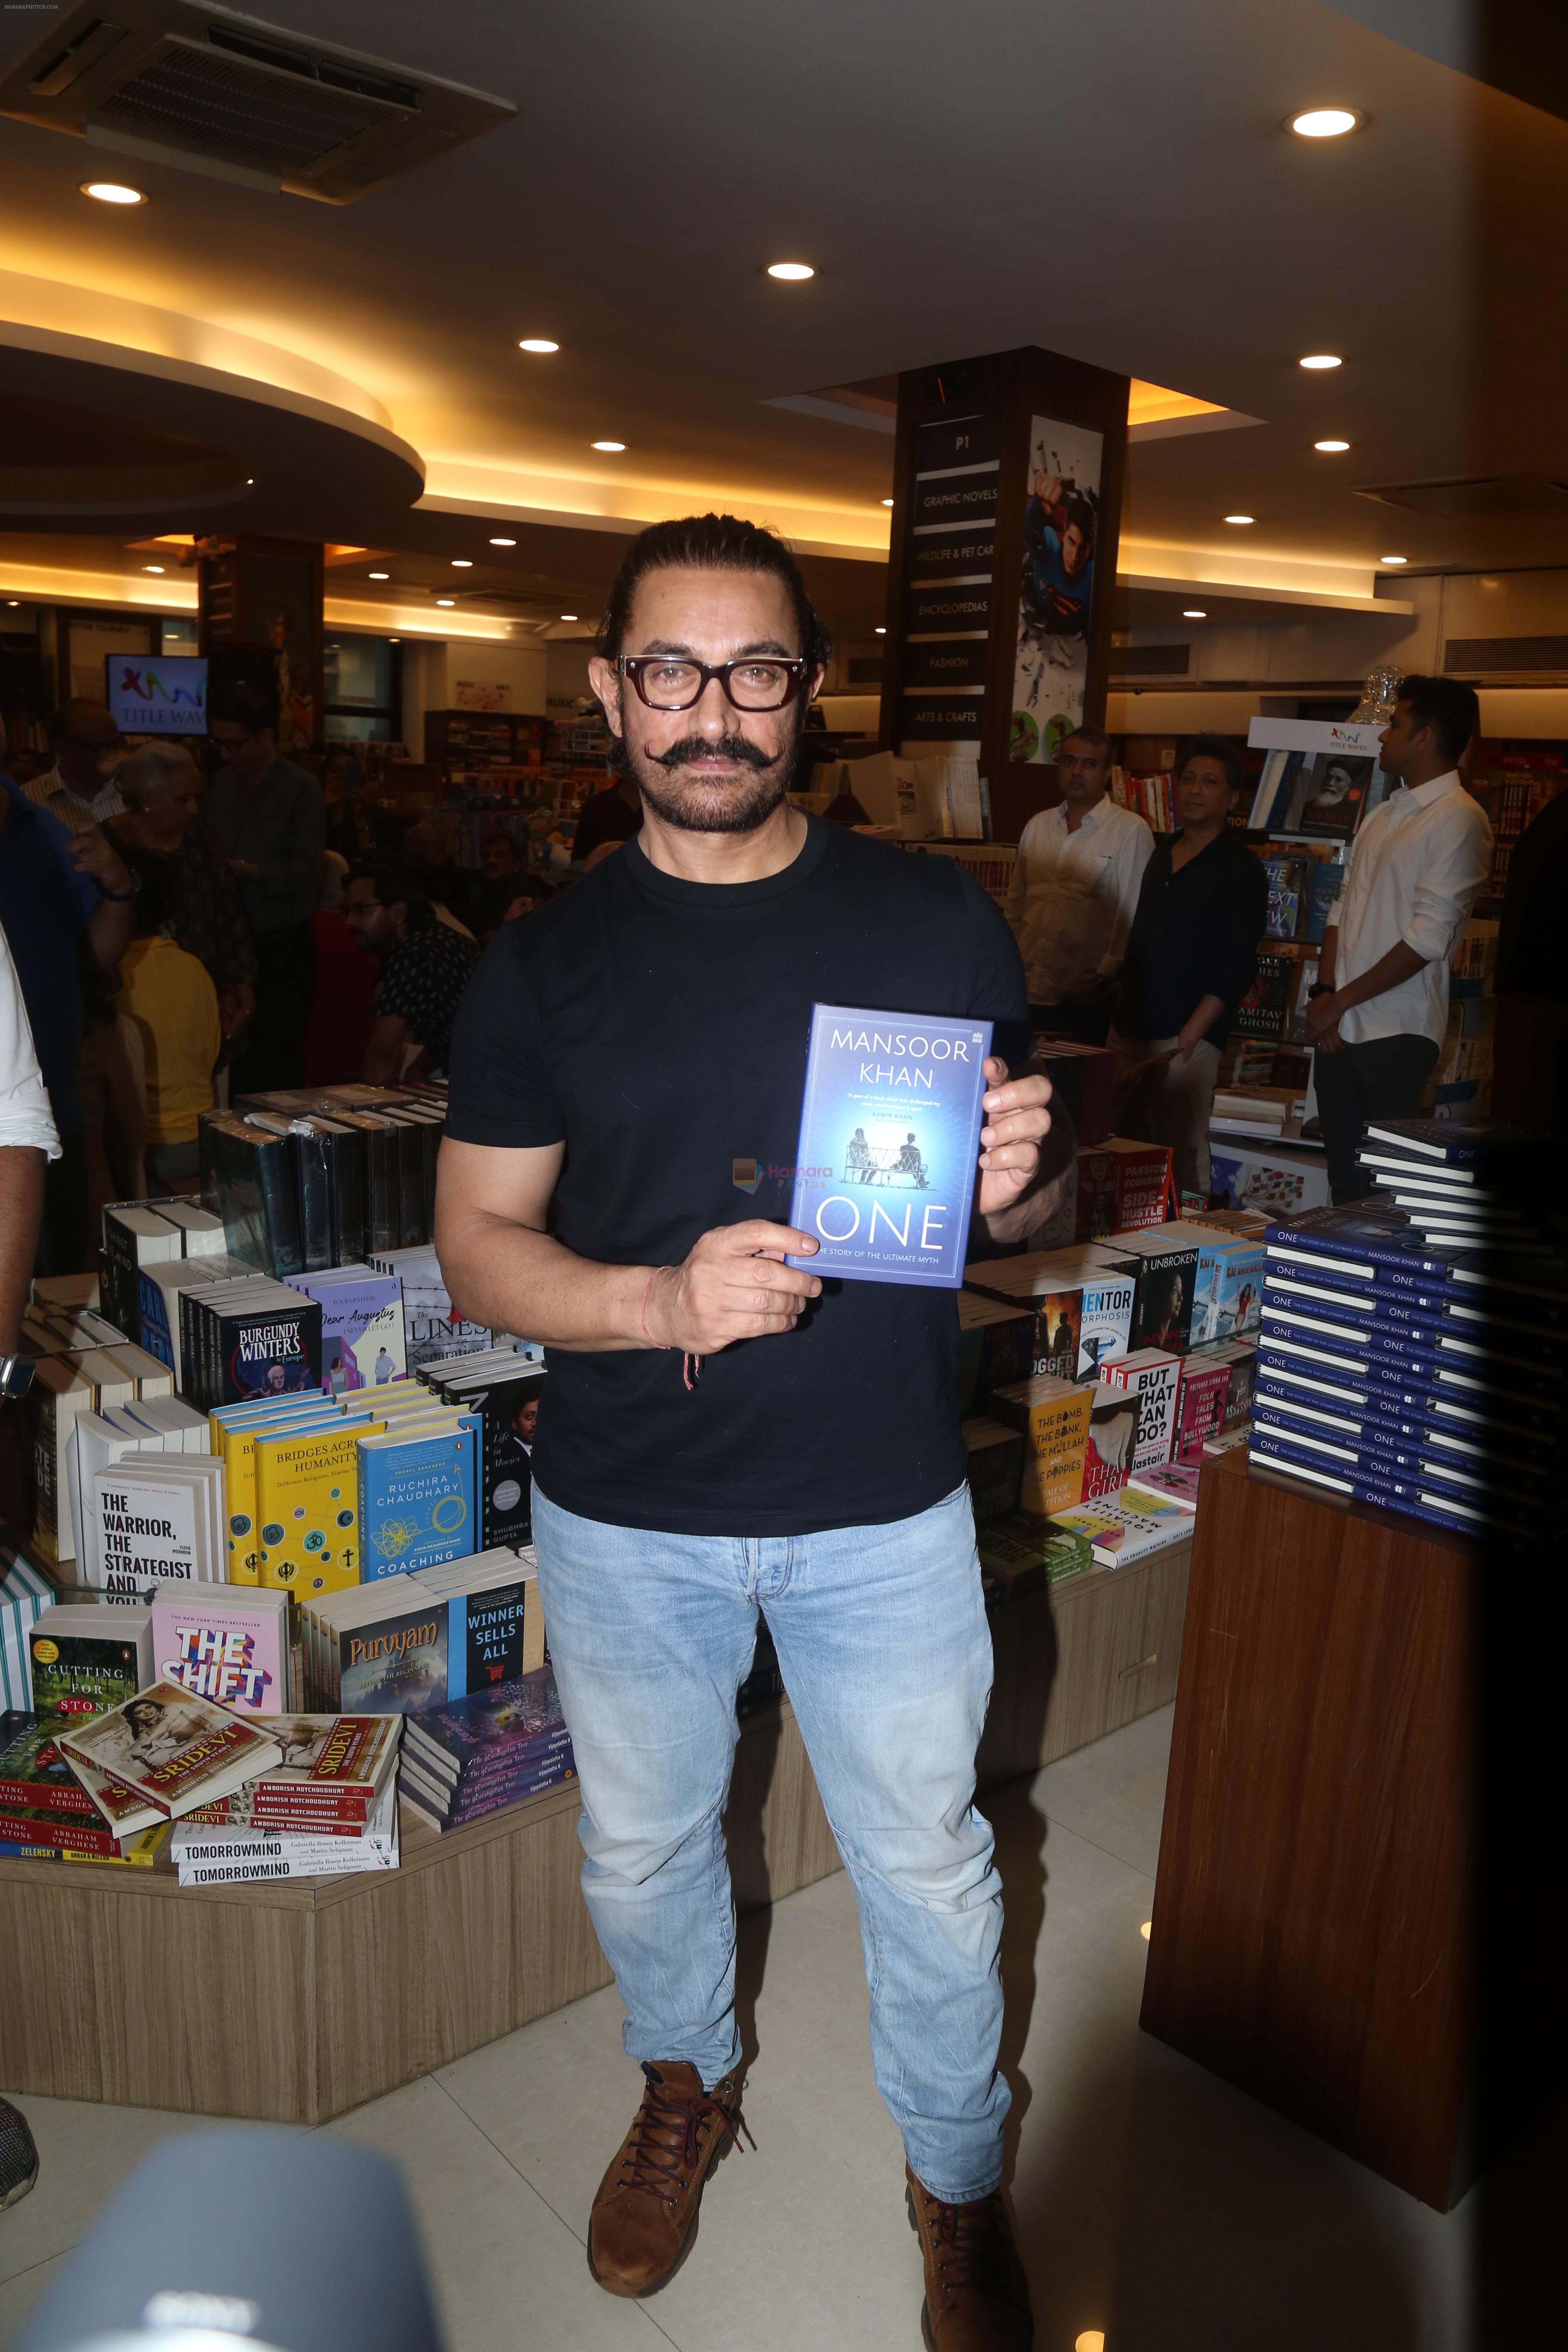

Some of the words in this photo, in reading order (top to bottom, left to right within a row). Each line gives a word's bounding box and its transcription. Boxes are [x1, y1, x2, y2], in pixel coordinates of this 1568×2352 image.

[956, 436, 969, 450] P1
[925, 494, 961, 507] GRAPHIC
[964, 489, 997, 502] NOVELS
[917, 549, 951, 561] WILDLIFE
[953, 549, 959, 558] &
[962, 547, 975, 557] PET
[919, 602, 987, 615] ENCYCLOPEDIAS
[930, 658, 968, 668] FASHION
[546, 698, 575, 708] MUSIC
[121, 708, 166, 722] TITLE
[916, 713, 936, 723] ARTS
[938, 713, 943, 722] &
[946, 712, 976, 723] CRAFTS
[1238, 1007, 1281, 1019] AMITAV
[1240, 1017, 1280, 1030] GHOSH
[831, 1029, 969, 1062] MANSOOR
[860, 1063, 933, 1088] KHAN
[1126, 1164, 1167, 1176] PASSION
[1124, 1176, 1166, 1188] ECONOMY
[1124, 1191, 1164, 1207] SIDE-
[1122, 1205, 1163, 1219] HUSTLE
[817, 1196, 946, 1250] ONE
[1121, 1217, 1162, 1228] REVOLUTION
[883, 1253, 916, 1262] ULTIMATE
[1278, 1232, 1297, 1243] ONE
[1368, 1252, 1400, 1263] MANSOOR
[1402, 1259, 1419, 1267] KHAN
[1151, 1253, 1197, 1270] UNBROKEN
[1393, 1275, 1414, 1286] ONE
[353, 1295, 376, 1304] PATHAK
[322, 1313, 345, 1326] Dear
[348, 1307, 395, 1325] Augustus
[239, 1322, 300, 1345] BURGUNDY
[240, 1336, 300, 1362] WINTERS
[282, 1354, 304, 1364] Europe
[1139, 1369, 1170, 1390] BUT
[1190, 1380, 1208, 1391] PRIYANKA
[1209, 1377, 1220, 1385] SINHA
[1199, 1391, 1214, 1403] FOLK
[1196, 1402, 1214, 1415] TALES
[1038, 1415, 1055, 1429] THE
[1195, 1413, 1212, 1426] FROM
[493, 1431, 509, 1444] Life
[1037, 1431, 1053, 1445] THE
[1136, 1422, 1167, 1445] DO?
[1185, 1421, 1219, 1440] BOLLYWOOD
[277, 1445, 328, 1463] BRIDGES
[294, 1452, 357, 1473] HUMANITY
[494, 1455, 521, 1468] Movies
[1050, 1456, 1062, 1465] AND
[1090, 1455, 1129, 1482] THAT
[1261, 1441, 1279, 1452] ONE
[1343, 1468, 1373, 1484] MANSOOR
[1375, 1478, 1391, 1490] KHAN
[277, 1479, 302, 1487] Different
[303, 1474, 330, 1482] Religions,
[331, 1468, 350, 1476] Similar
[389, 1475, 447, 1493] RUCHIRA
[1088, 1473, 1124, 1499] GIRL
[101, 1492, 129, 1513] THE
[377, 1483, 459, 1506] CHAUDHARY
[1366, 1493, 1386, 1507] ONE
[103, 1513, 176, 1540] WARRIOR,
[493, 1522, 529, 1535] SHUBHRA
[105, 1534, 132, 1553] THE
[493, 1532, 518, 1543] GUPTA
[1130, 1548, 1148, 1559] EQUALITY
[1150, 1540, 1167, 1550] MACHINE
[104, 1553, 192, 1580] STRATEGIST
[378, 1551, 454, 1574] COACHING
[107, 1574, 137, 1592] AND
[468, 1604, 524, 1629] WINNER
[476, 1623, 515, 1645] SELLS
[176, 1626, 251, 1666] THE
[351, 1621, 438, 1666] Purvyam
[483, 1643, 508, 1660] ALL
[49, 1664, 123, 1678] CUTTING
[72, 1684, 103, 1694] FOR
[162, 1660, 267, 1701] SHIFT
[153, 1729, 238, 1783] SRIDEVI
[178, 1769, 191, 1778] THE
[191, 1756, 210, 1773] SOUTH
[211, 1743, 232, 1759] YEARS
[171, 1772, 208, 1798] AMBORISH
[209, 1737, 263, 1778] ROYCHOUDHURY
[296, 1785, 344, 1794] ROYCHOUDHURY
[52, 1837, 100, 1850] VERGHESE
[54, 1830, 97, 1842] ABRAHAM
[21, 1847, 55, 1858] ZELENSKY
[185, 1843, 282, 1861] TOMORROWMIND
[193, 1862, 290, 1882] TOMORROWMIND
